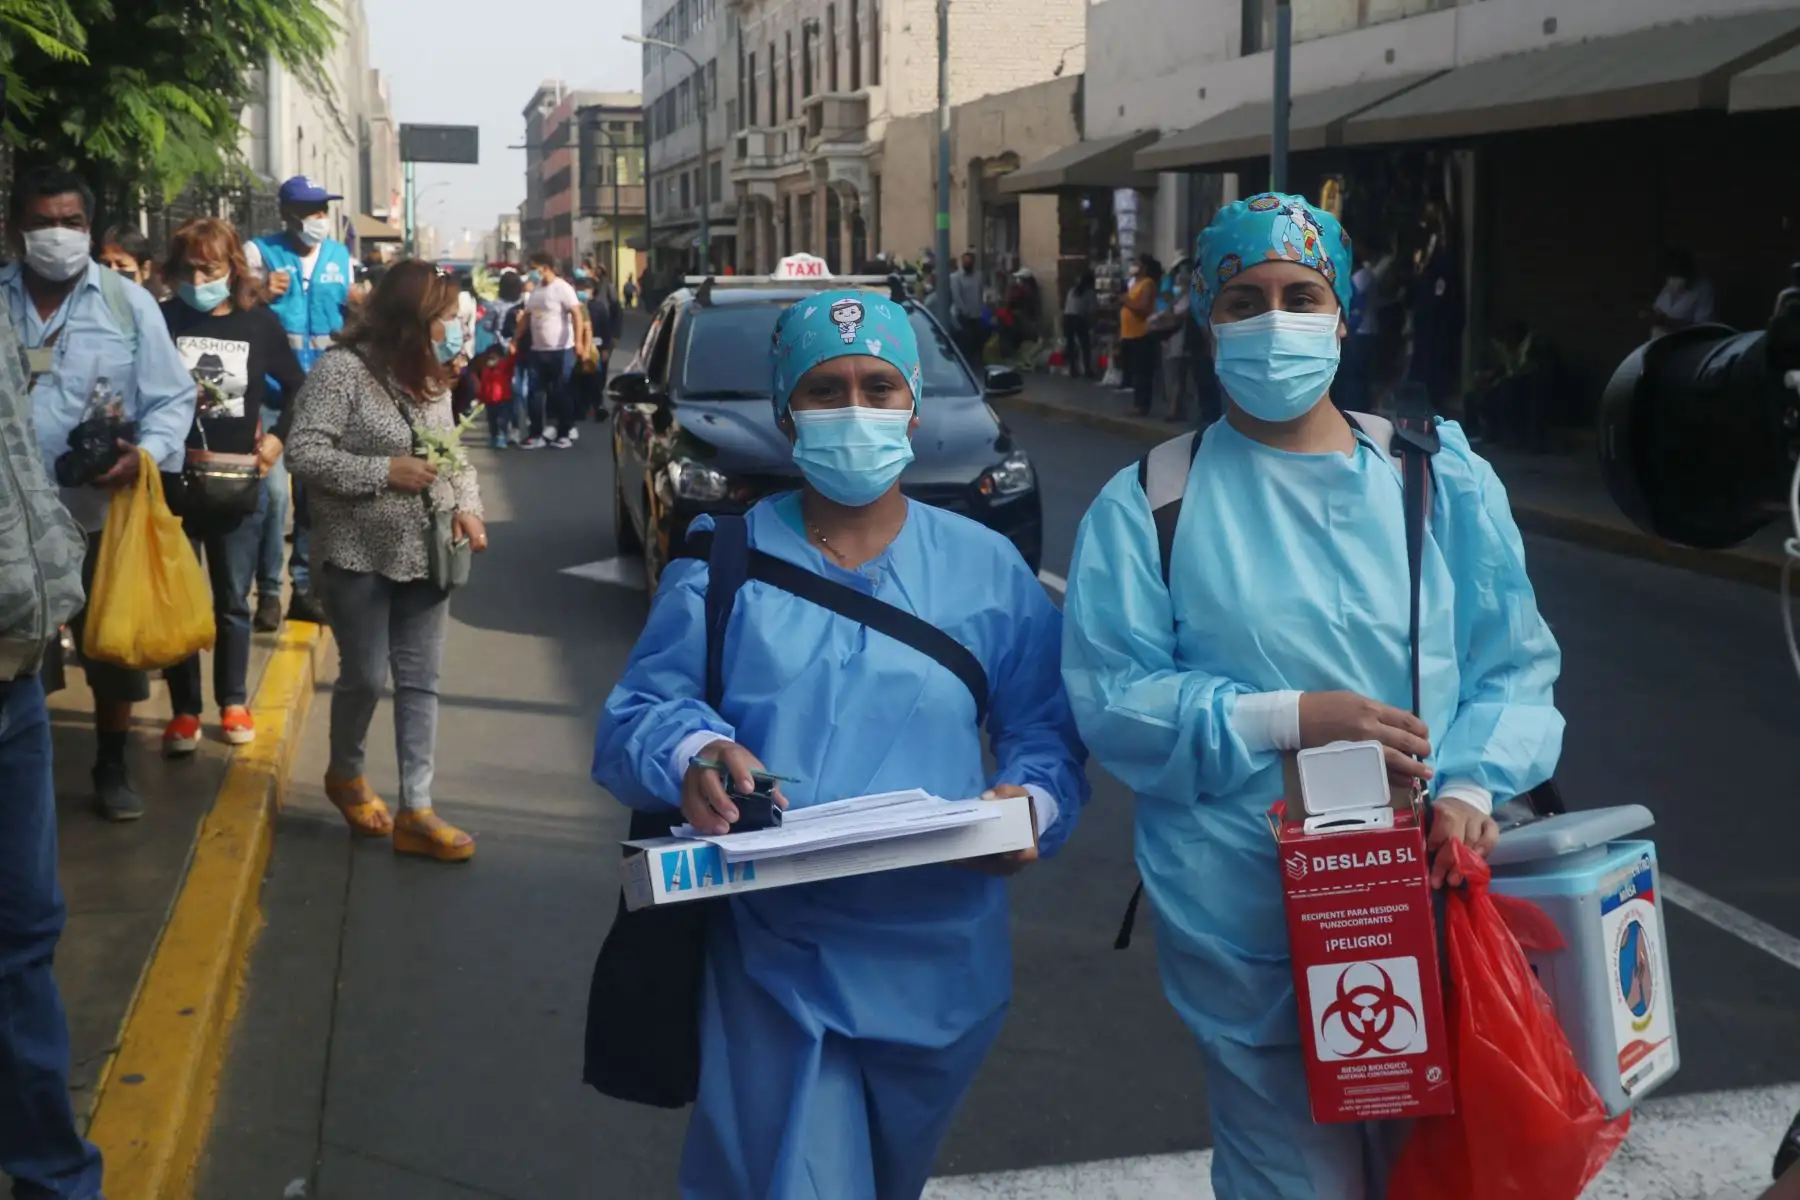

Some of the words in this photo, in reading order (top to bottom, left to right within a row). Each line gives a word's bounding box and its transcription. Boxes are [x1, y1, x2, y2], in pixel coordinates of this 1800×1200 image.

[785, 262, 822, 276] TAXI
[179, 338, 246, 353] FASHION
[1312, 849, 1392, 872] DESLAB
[1396, 847, 1417, 863] 5L
[1301, 910, 1345, 921] RECIPIENTE
[1347, 907, 1368, 917] PARA
[1369, 903, 1409, 914] RESIDUOS
[1319, 915, 1393, 930] PUNZOCORTANTES
[1325, 933, 1393, 952] ¡PELIGRO!
[1337, 1072, 1366, 1080] MATERIAL
[1341, 1064, 1367, 1074] RIESGO
